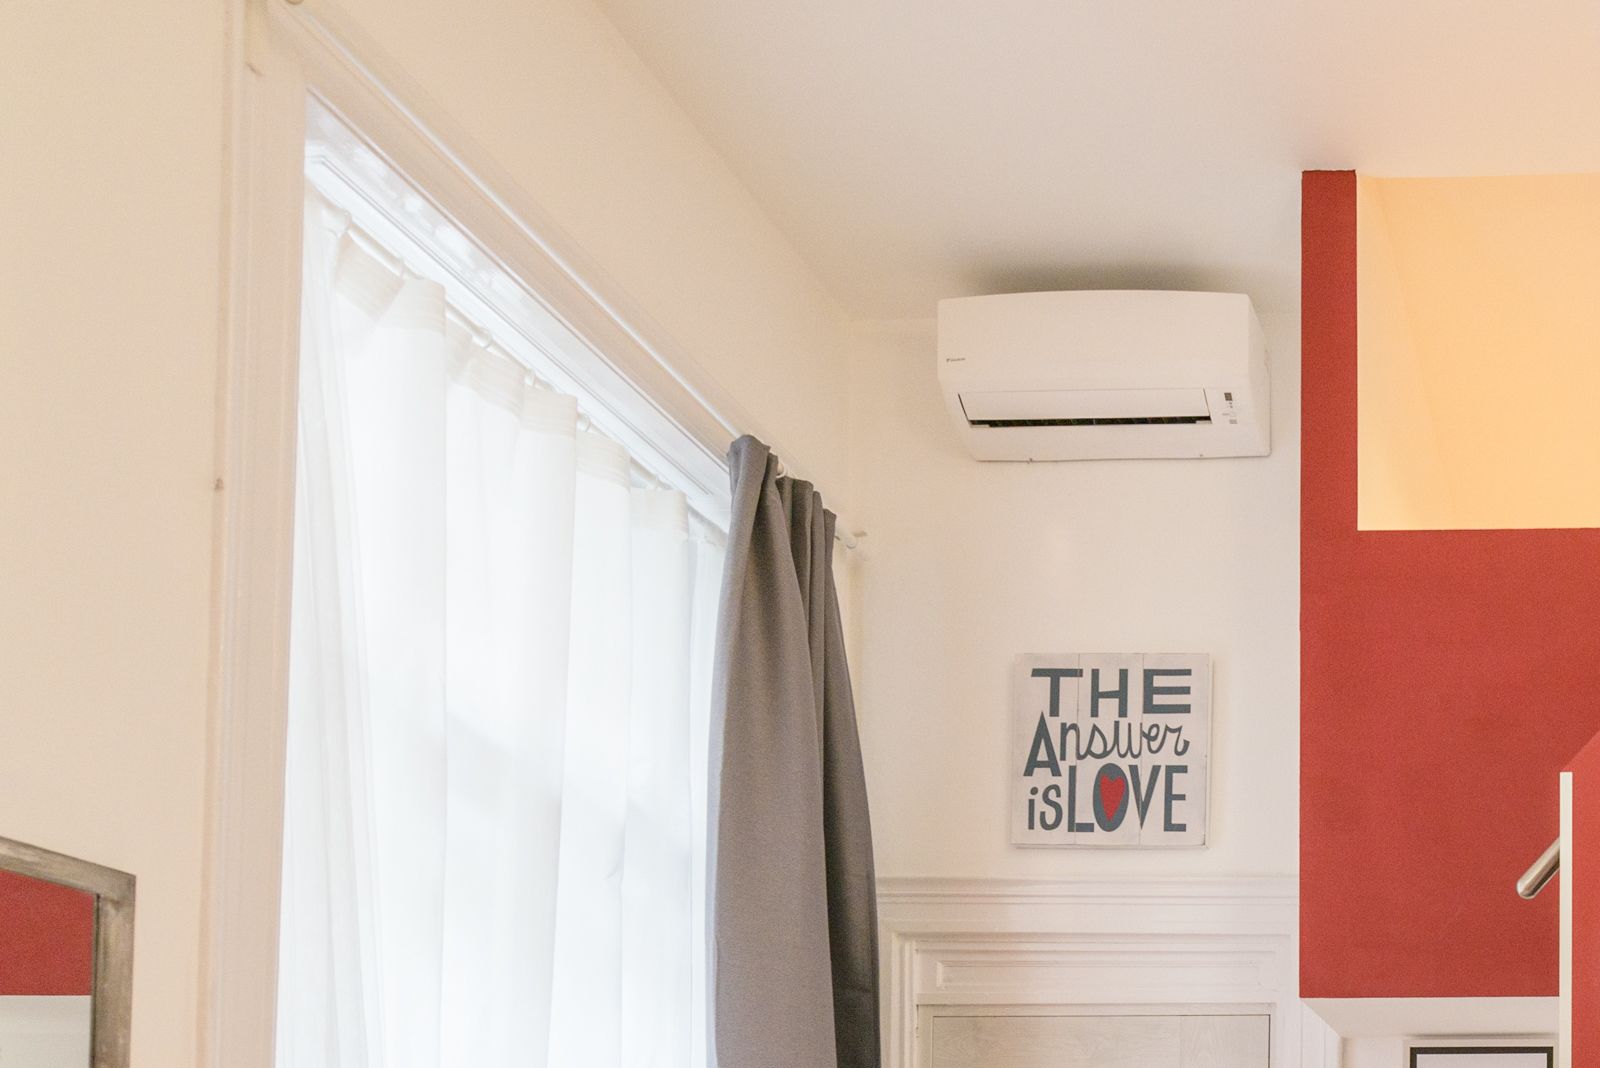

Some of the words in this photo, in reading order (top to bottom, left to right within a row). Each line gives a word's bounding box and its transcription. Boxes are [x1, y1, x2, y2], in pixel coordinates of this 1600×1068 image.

[1031, 668, 1192, 718] THE
[1023, 711, 1190, 777] Answer
[1067, 763, 1188, 832] LOVE
